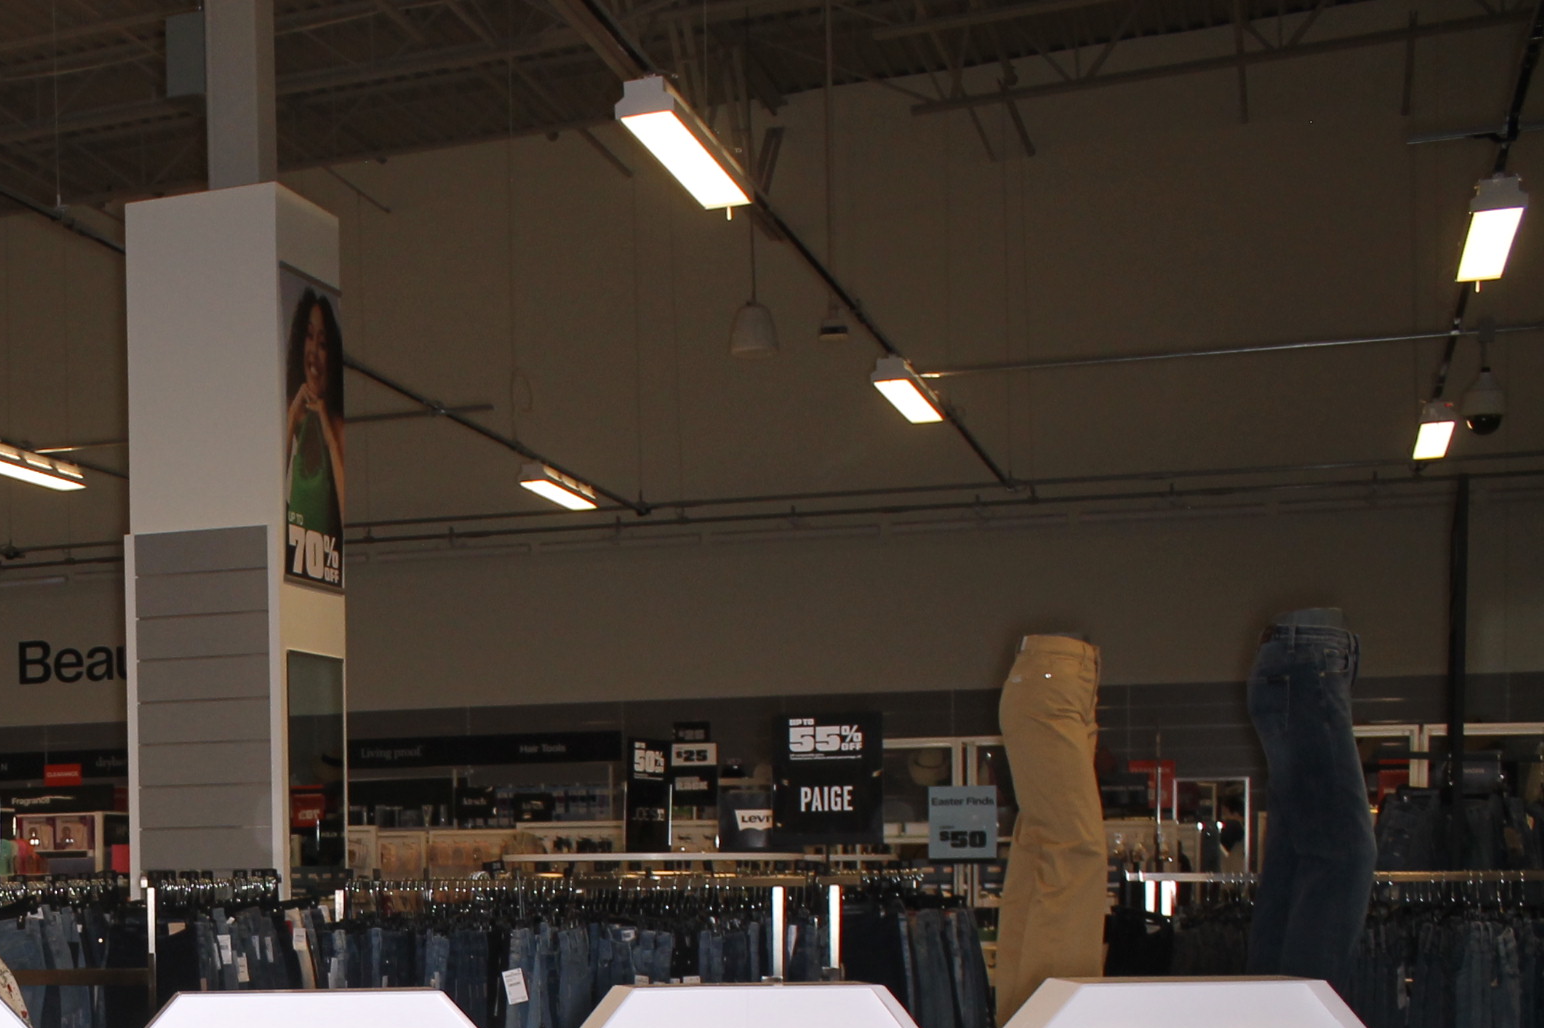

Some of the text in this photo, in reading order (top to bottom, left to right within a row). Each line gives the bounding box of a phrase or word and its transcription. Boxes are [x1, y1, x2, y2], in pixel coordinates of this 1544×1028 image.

[288, 523, 339, 579] 70%
[324, 566, 339, 583] OFF
[789, 724, 862, 752] 55%
[840, 742, 863, 751] OFF
[675, 750, 707, 762] $25
[800, 785, 854, 812] PAIGE
[931, 797, 994, 806] Easter Finds
[939, 831, 986, 848] $50
